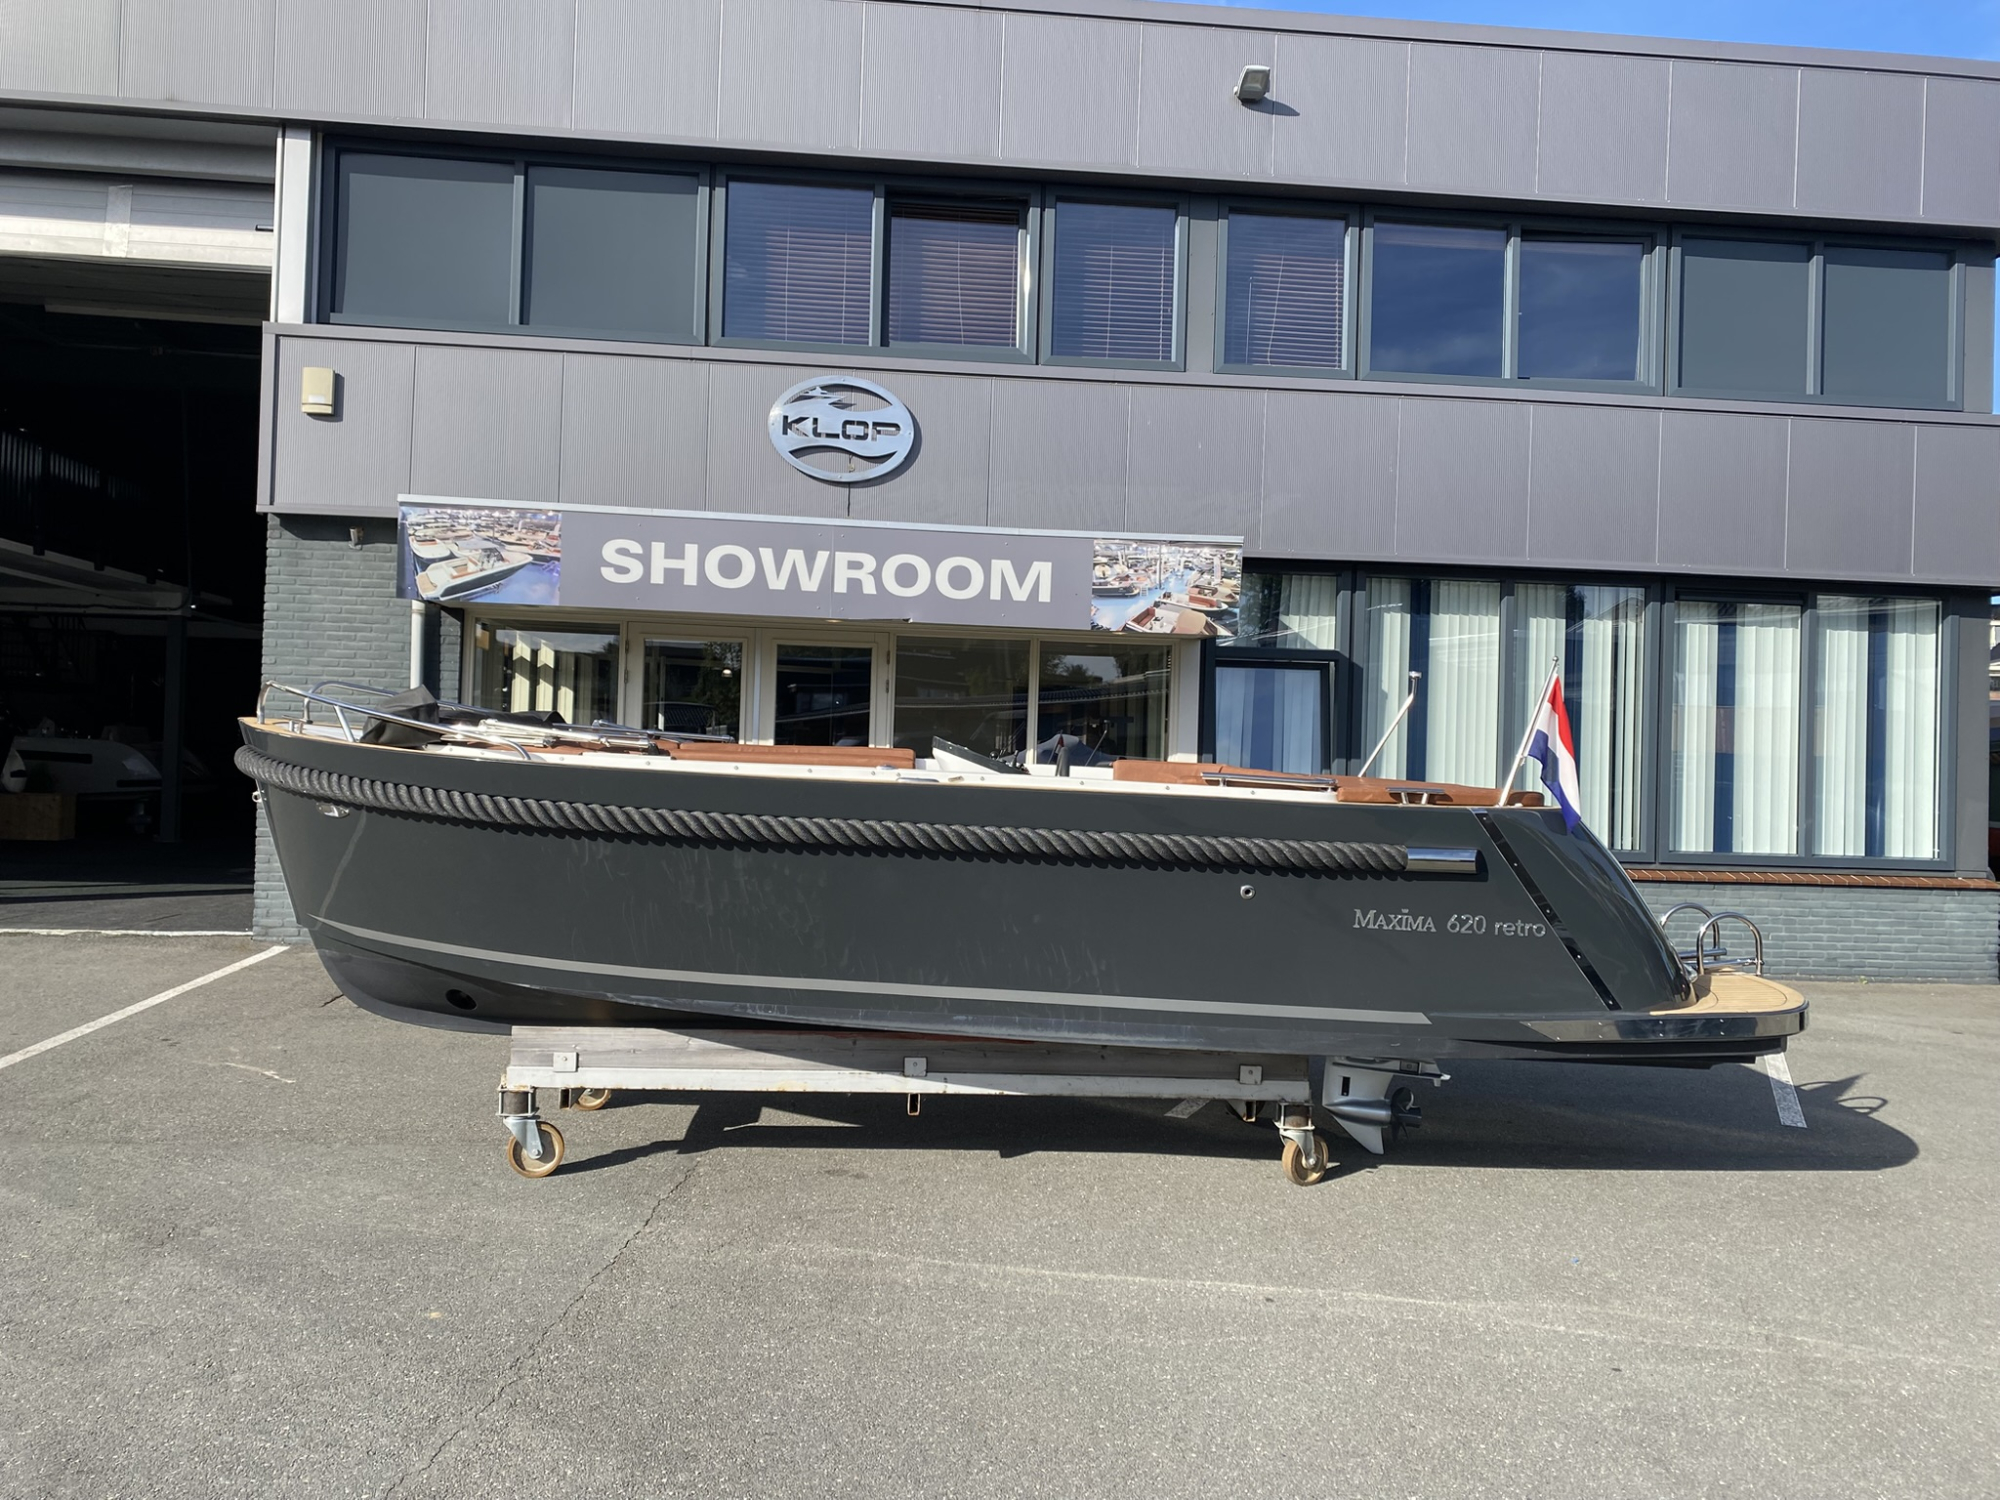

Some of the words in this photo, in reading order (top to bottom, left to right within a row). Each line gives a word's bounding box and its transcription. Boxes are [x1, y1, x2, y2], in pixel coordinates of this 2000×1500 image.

[782, 415, 901, 442] KLOP
[600, 538, 1053, 603] SHOWROOM
[1446, 914, 1486, 934] 620
[1494, 919, 1546, 937] retro
